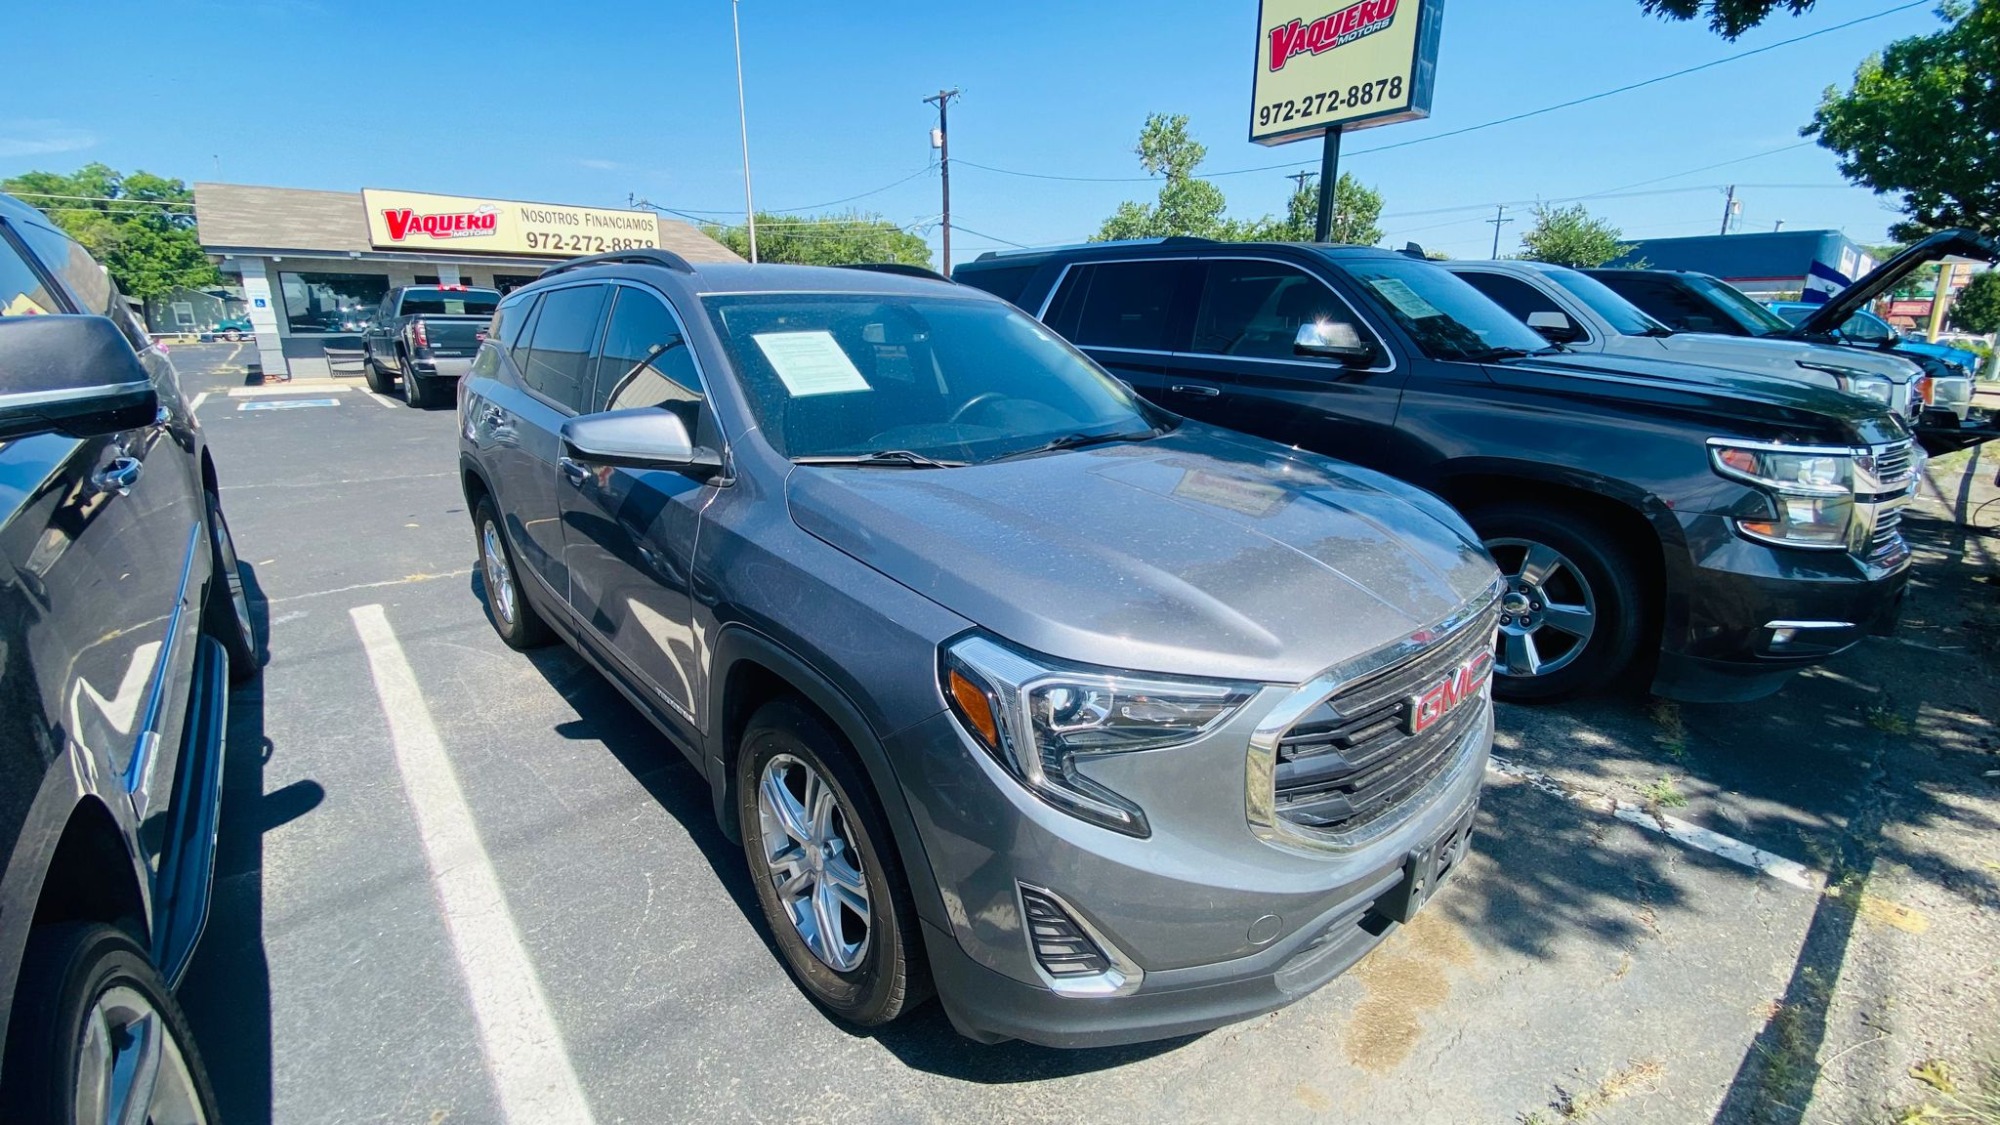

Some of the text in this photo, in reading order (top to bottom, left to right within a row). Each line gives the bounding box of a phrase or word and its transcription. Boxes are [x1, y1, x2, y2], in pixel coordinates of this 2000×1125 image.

[1269, 0, 1398, 71] VAQUERO
[1338, 19, 1389, 45] MOTORS
[1259, 76, 1402, 126] 972-272-8878
[382, 208, 497, 241] VAQUERO
[520, 207, 654, 231] NOSOTROS FINANCIAMOS
[1415, 651, 1492, 733] GMC
